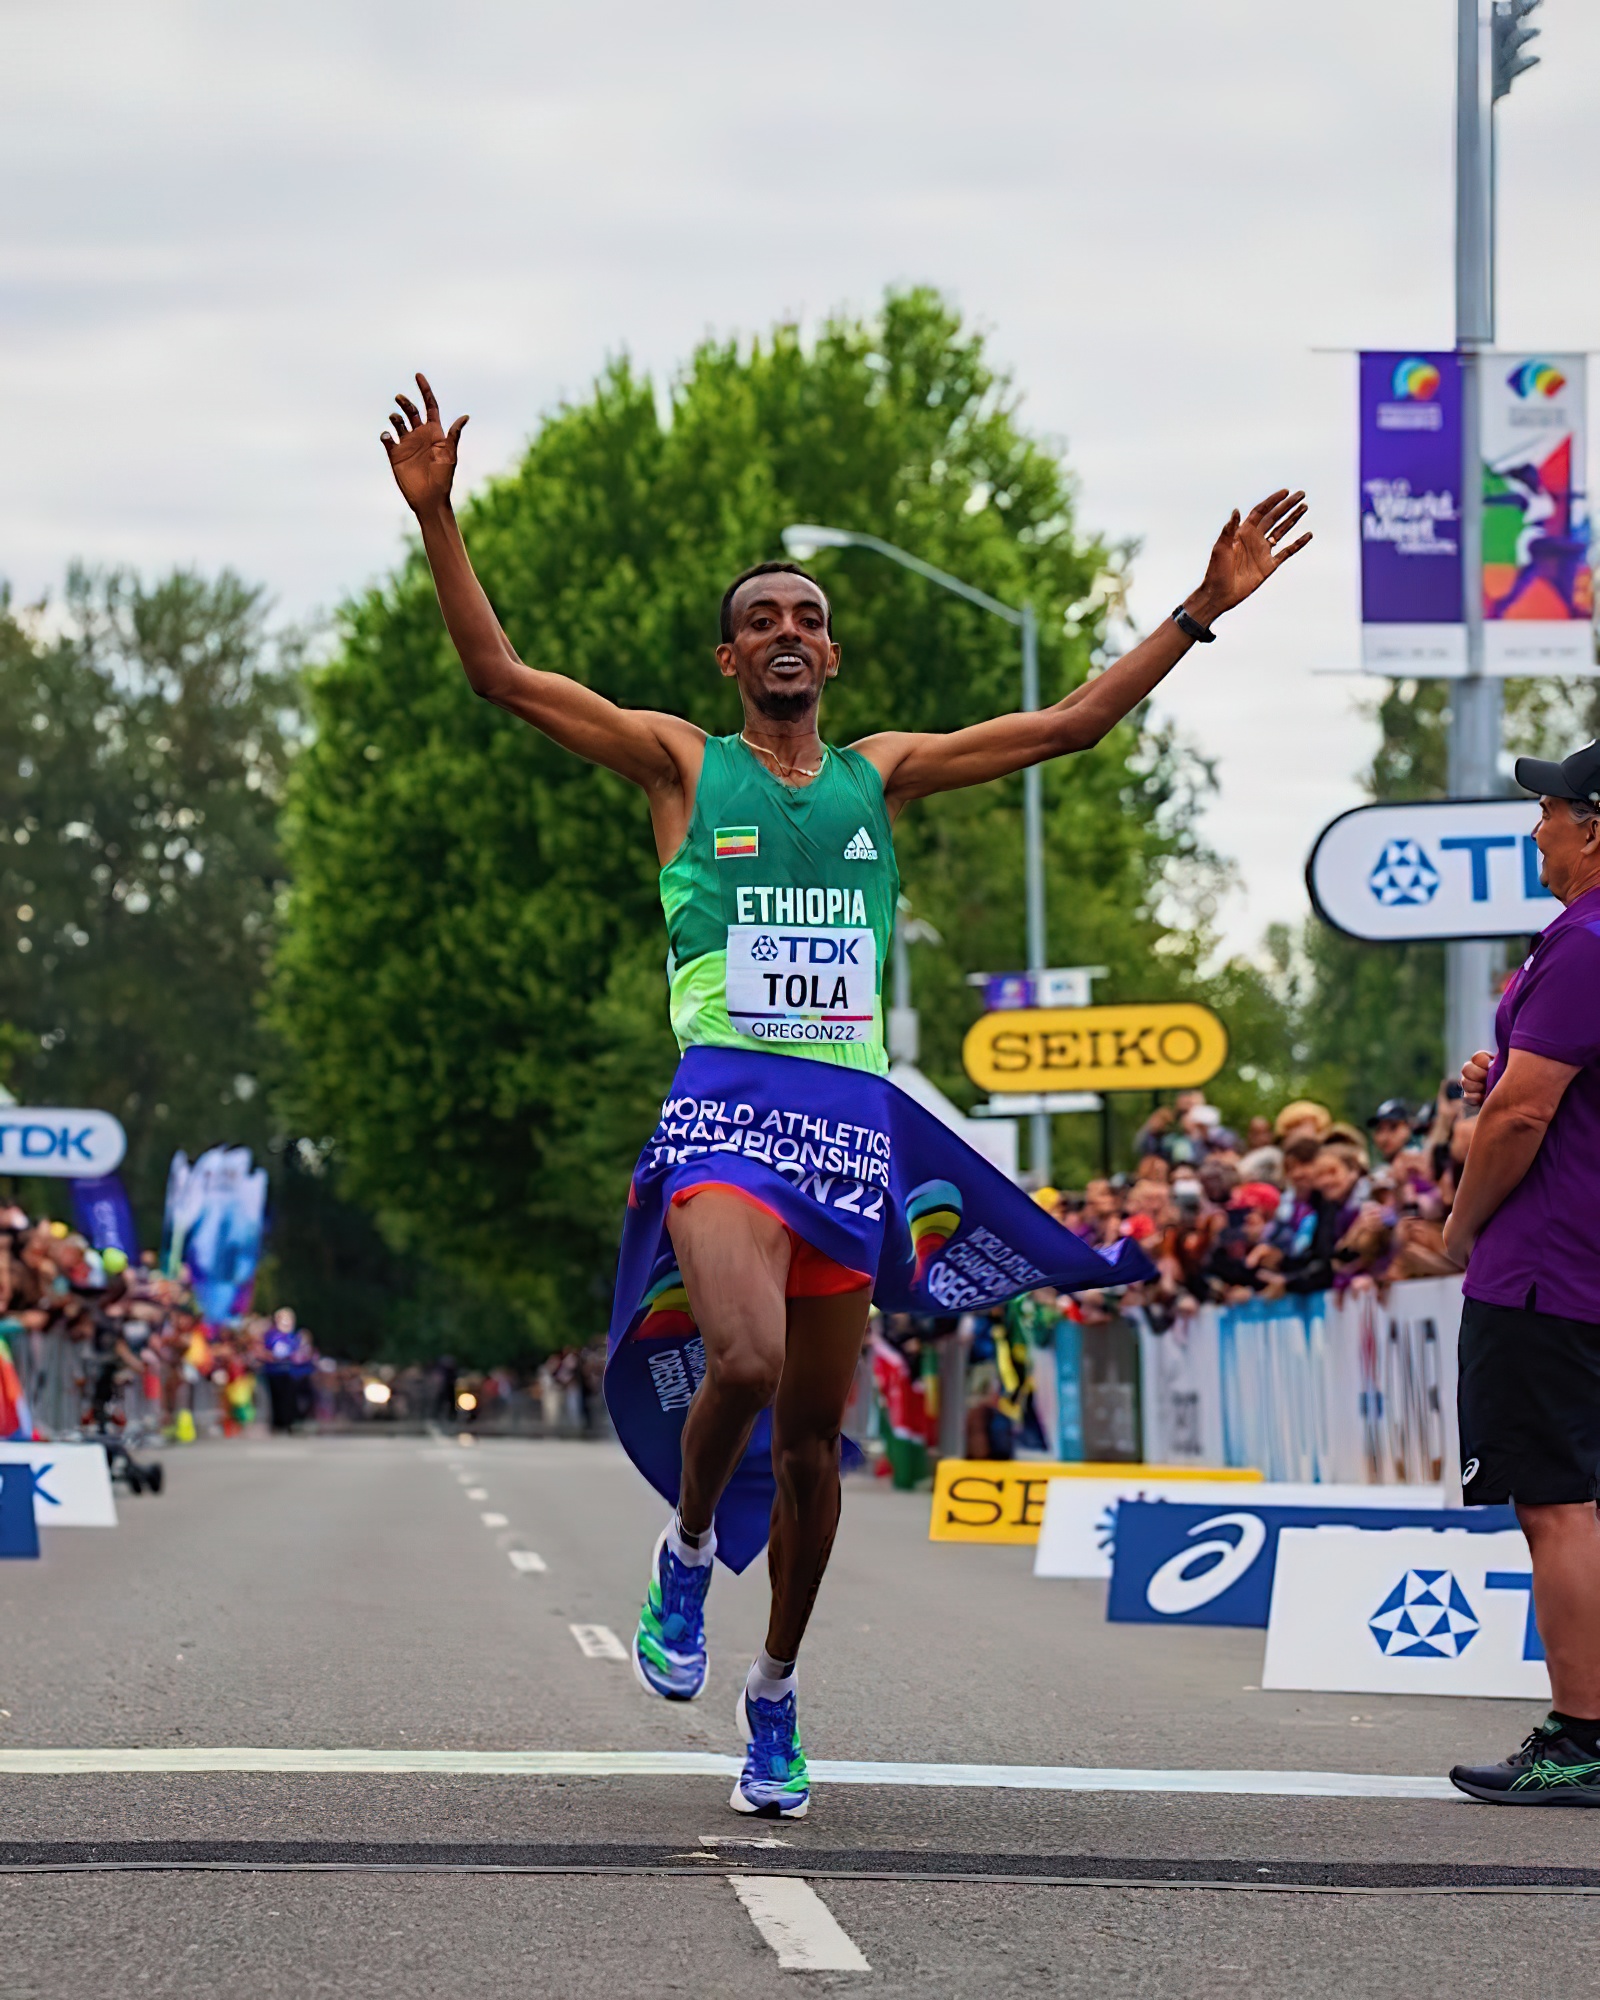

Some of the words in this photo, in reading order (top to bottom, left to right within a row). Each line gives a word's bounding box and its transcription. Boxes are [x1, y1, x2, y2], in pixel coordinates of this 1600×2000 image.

[736, 886, 867, 925] ETHIOPIA
[779, 936, 859, 965] TDK
[763, 973, 849, 1009] TOLA
[751, 1022, 856, 1041] OREGON22
[991, 1025, 1201, 1073] SEIKO
[662, 1097, 755, 1126] WORLD
[760, 1109, 891, 1160] ATHLETICS
